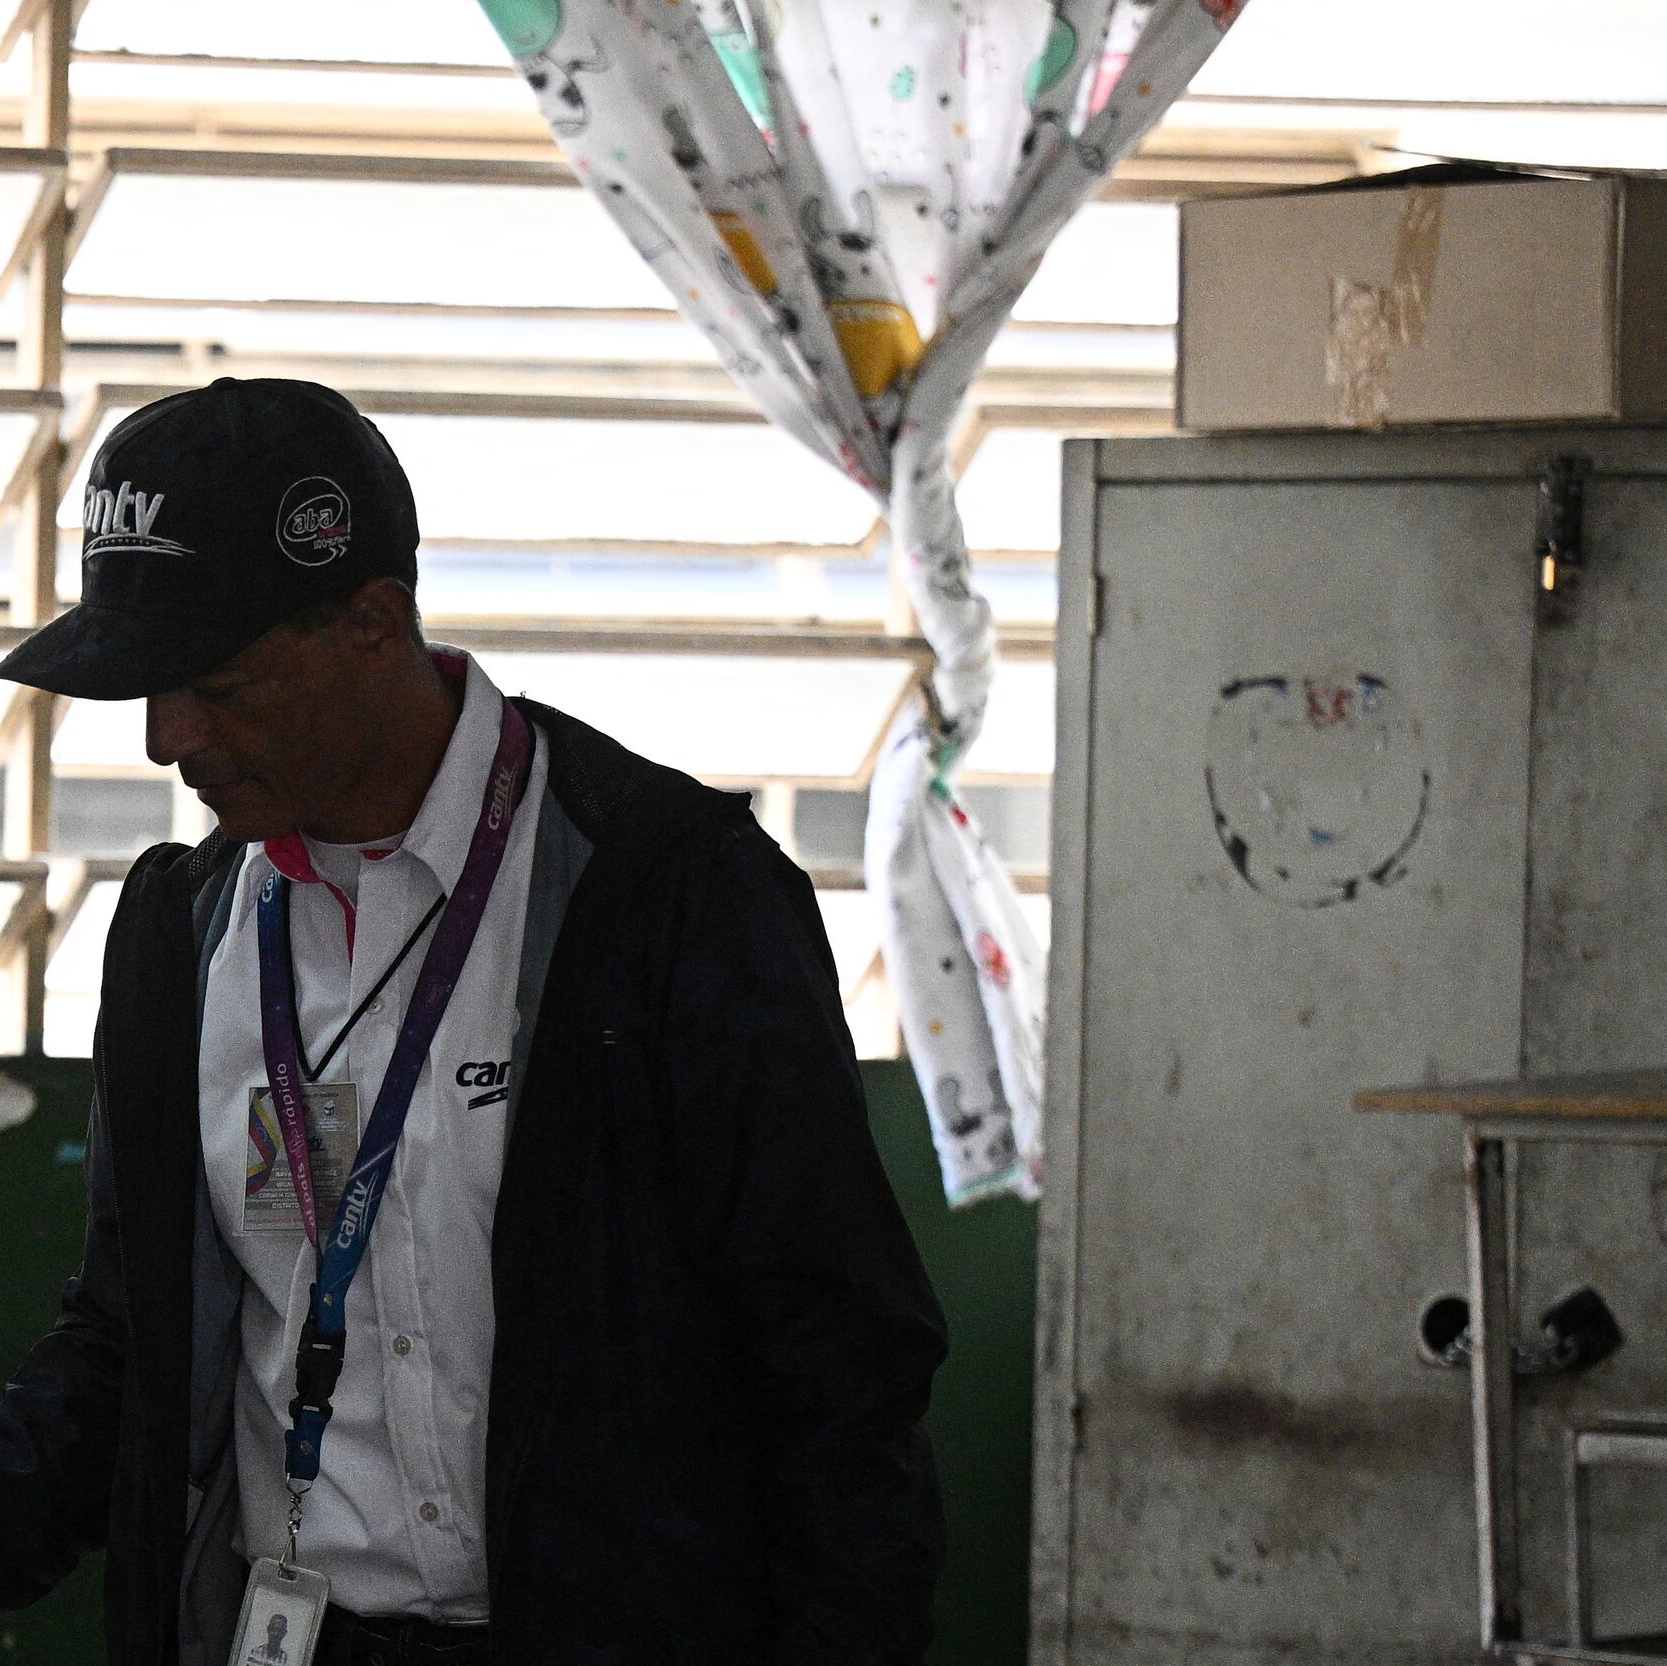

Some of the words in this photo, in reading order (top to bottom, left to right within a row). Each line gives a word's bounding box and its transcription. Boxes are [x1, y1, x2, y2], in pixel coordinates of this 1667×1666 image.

[83, 481, 165, 537] antv
[292, 508, 333, 535] aba
[275, 1063, 297, 1126] rápido
[337, 1180, 368, 1249] cantv
